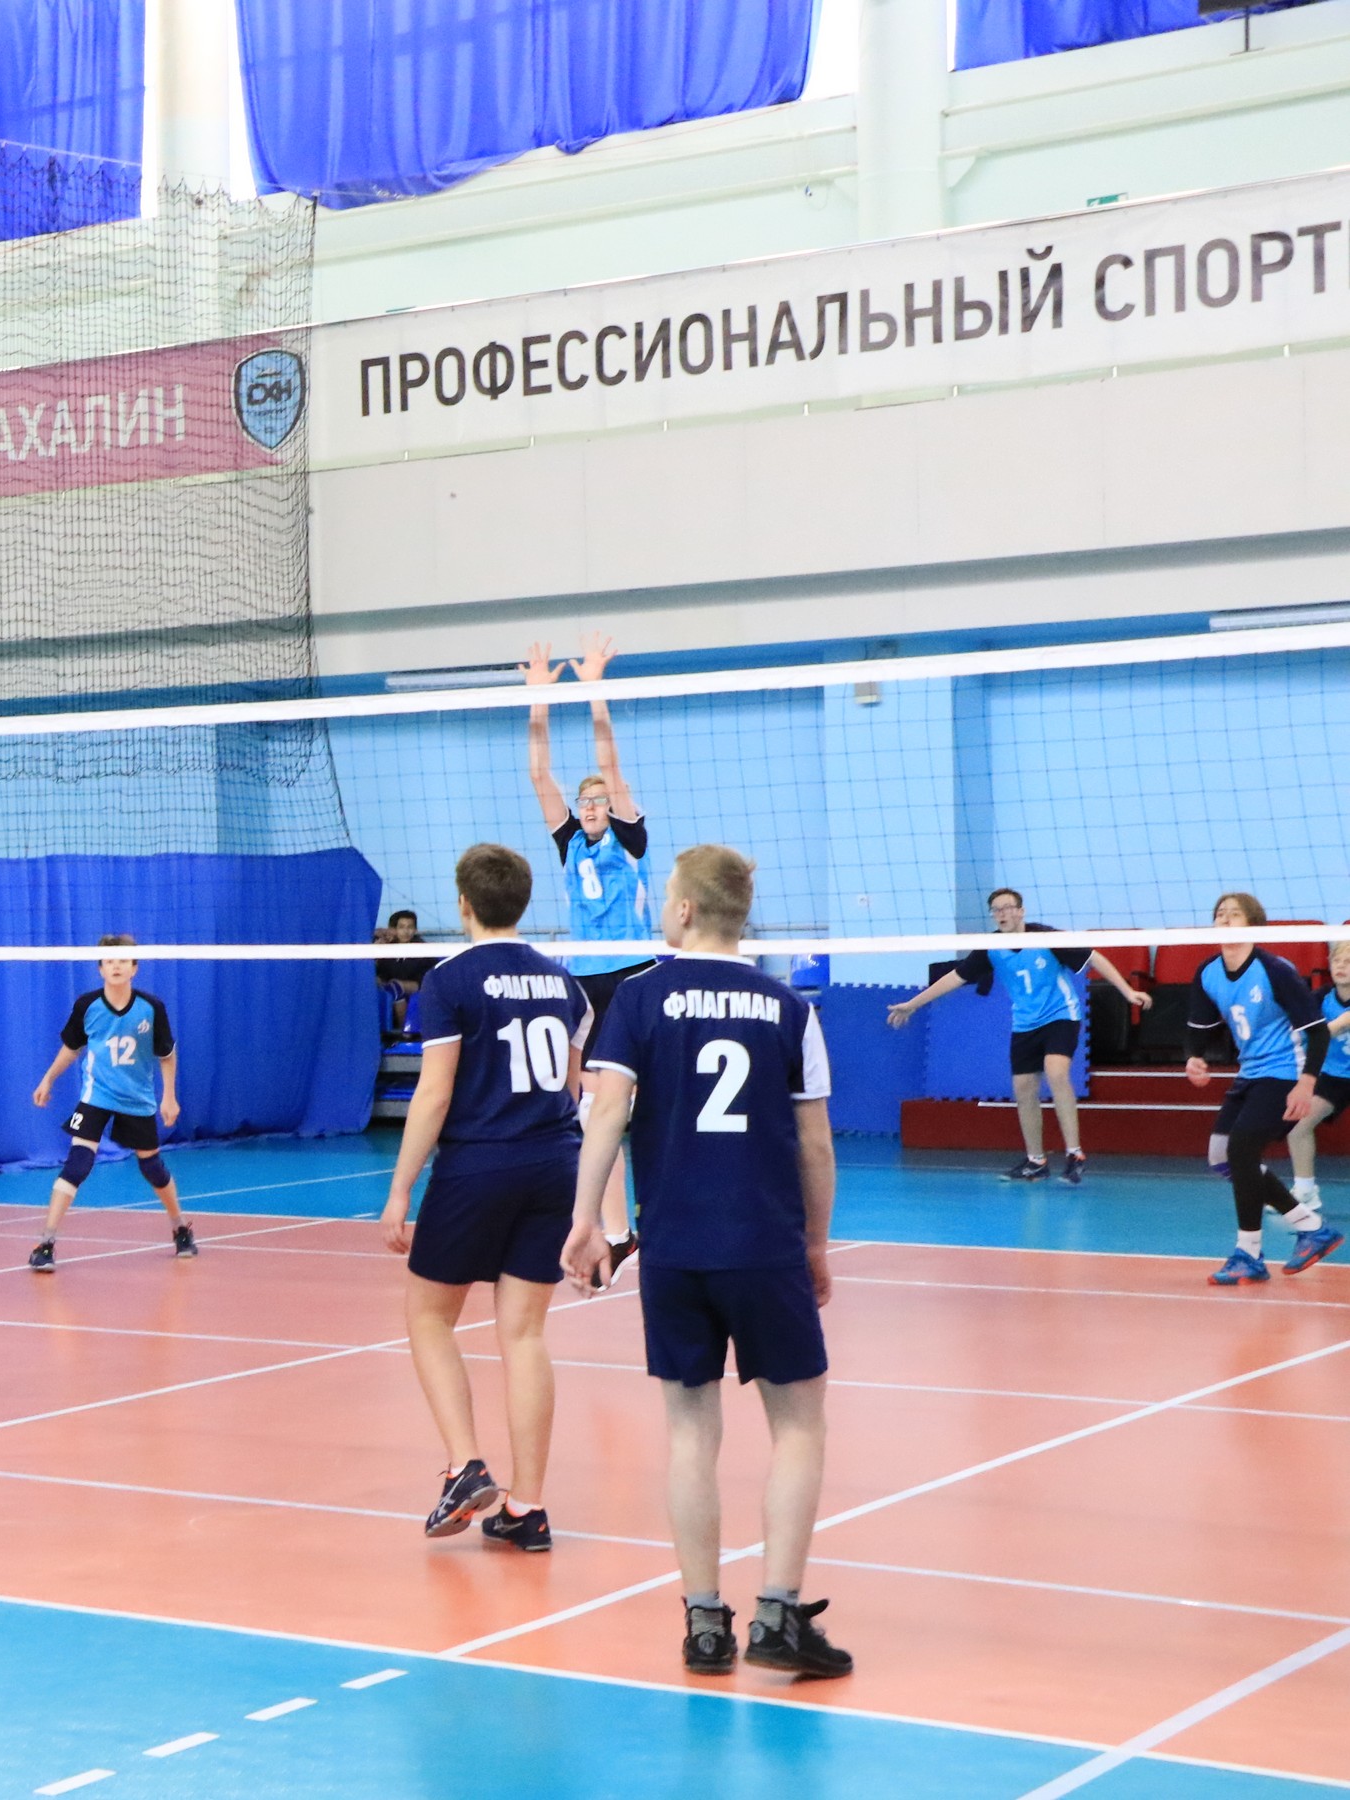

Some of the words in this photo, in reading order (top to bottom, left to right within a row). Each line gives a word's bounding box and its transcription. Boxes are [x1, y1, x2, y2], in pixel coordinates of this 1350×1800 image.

[360, 245, 1063, 417] ПРОФЕССИОНАЛЬНЫЙ
[1094, 220, 1350, 322] СПОРТ
[579, 857, 603, 899] 8
[483, 974, 568, 1000] ФЛАГМАН
[1015, 969, 1032, 994] 7
[663, 989, 781, 1025] ФЛАГМАН
[1230, 1005, 1251, 1041] 5
[105, 1035, 137, 1067] 12
[497, 1015, 569, 1094] 10
[696, 1039, 751, 1133] 2
[69, 1112, 84, 1131] 12
